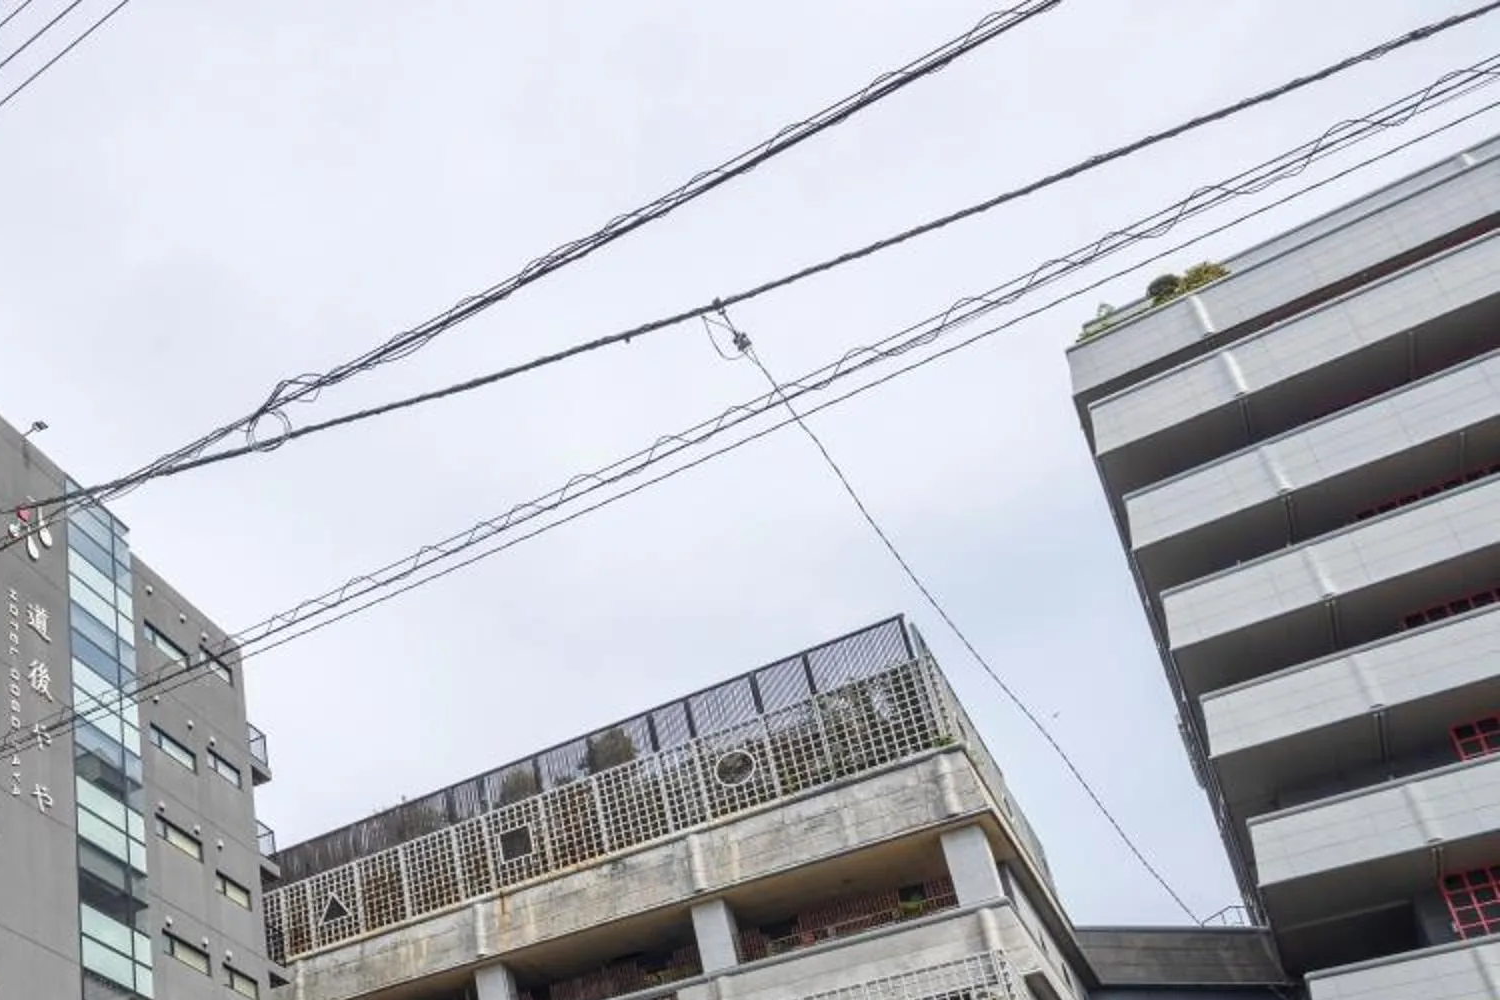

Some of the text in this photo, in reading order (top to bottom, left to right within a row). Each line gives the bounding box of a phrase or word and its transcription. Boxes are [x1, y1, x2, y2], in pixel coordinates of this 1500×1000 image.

[8, 588, 19, 655] HOTEL
[10, 667, 21, 731] DOGO
[26, 602, 53, 814] 道後やや
